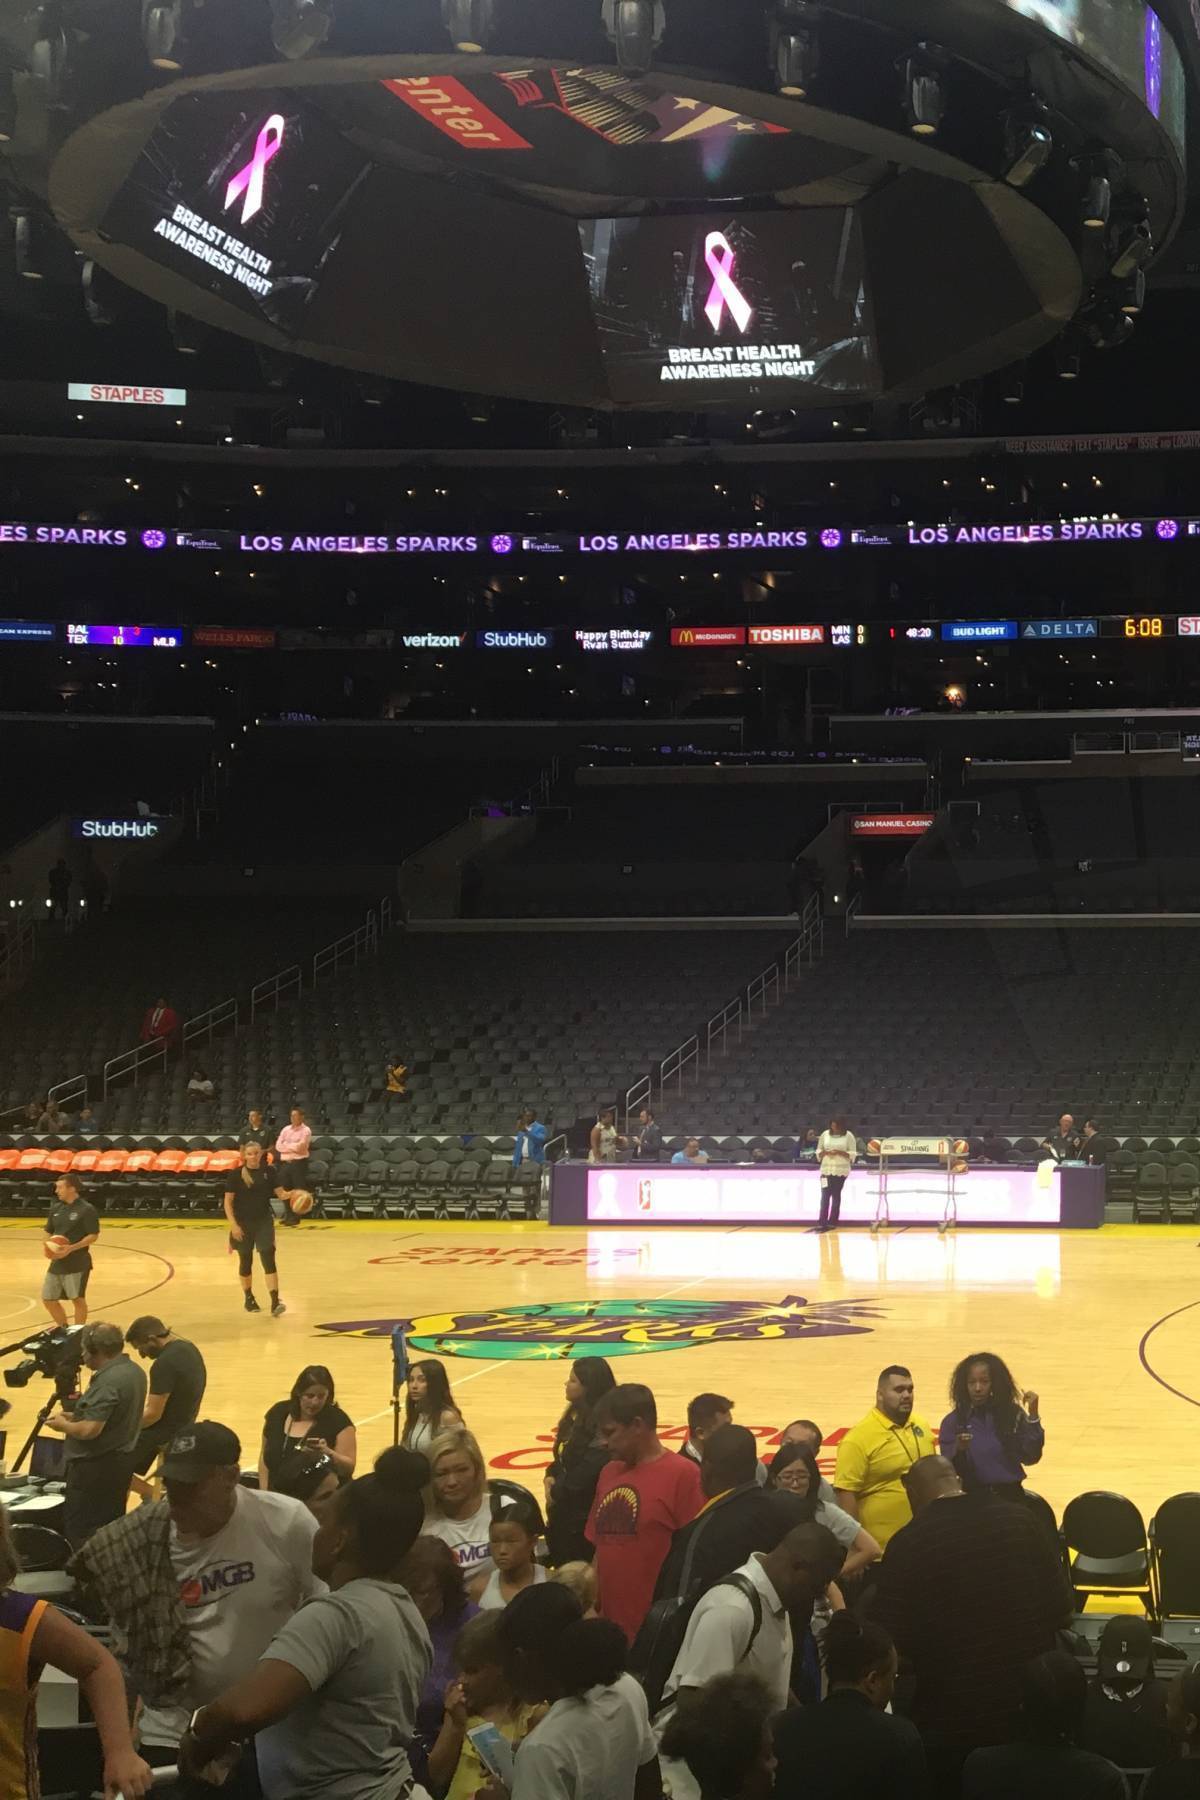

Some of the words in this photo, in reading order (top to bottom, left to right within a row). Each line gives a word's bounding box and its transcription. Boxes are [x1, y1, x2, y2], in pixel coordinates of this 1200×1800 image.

[172, 204, 226, 246] BREAST
[223, 235, 272, 274] HEALTH
[153, 218, 236, 275] AWARENESS
[233, 263, 273, 296] NIGHT
[668, 346, 733, 363] BREAST
[737, 344, 801, 361] HEALTH
[660, 362, 763, 380] AWARENESS
[764, 360, 816, 376] NIGHT
[90, 385, 165, 403] STAPLES
[36, 527, 127, 545] SPARKS
[909, 528, 949, 544] LOS
[956, 524, 1053, 542] ANGELES
[1061, 522, 1142, 540] SPARKS
[240, 534, 283, 551] LOS
[290, 536, 388, 552] ANGELES
[396, 536, 477, 552] SPARKS
[579, 535, 618, 551] LOS
[625, 534, 720, 550] ANGELES
[727, 532, 807, 548] SPARKS
[67, 624, 89, 635] BAL
[831, 625, 849, 635] MIN
[953, 627, 974, 636] BUD
[975, 626, 1005, 636] LIGHT
[1041, 623, 1095, 635] DELTA
[1125, 618, 1161, 636] 6:08
[67, 634, 88, 644] TEX
[112, 635, 124, 645] 10
[153, 637, 176, 647] MLB
[194, 632, 233, 643] WELLS
[235, 632, 274, 644] FARGO
[402, 632, 460, 647] verizon
[484, 632, 546, 647] StubHub
[576, 631, 608, 641] Happy
[610, 630, 651, 641] Birthday
[751, 628, 823, 642] TOSHIBA
[832, 634, 850, 645] LAS
[611, 639, 643, 649] Suzuki
[82, 820, 158, 838] StubHub
[860, 820, 875, 828] SAN
[876, 820, 904, 828] MANUEL
[906, 820, 933, 828] CASINO
